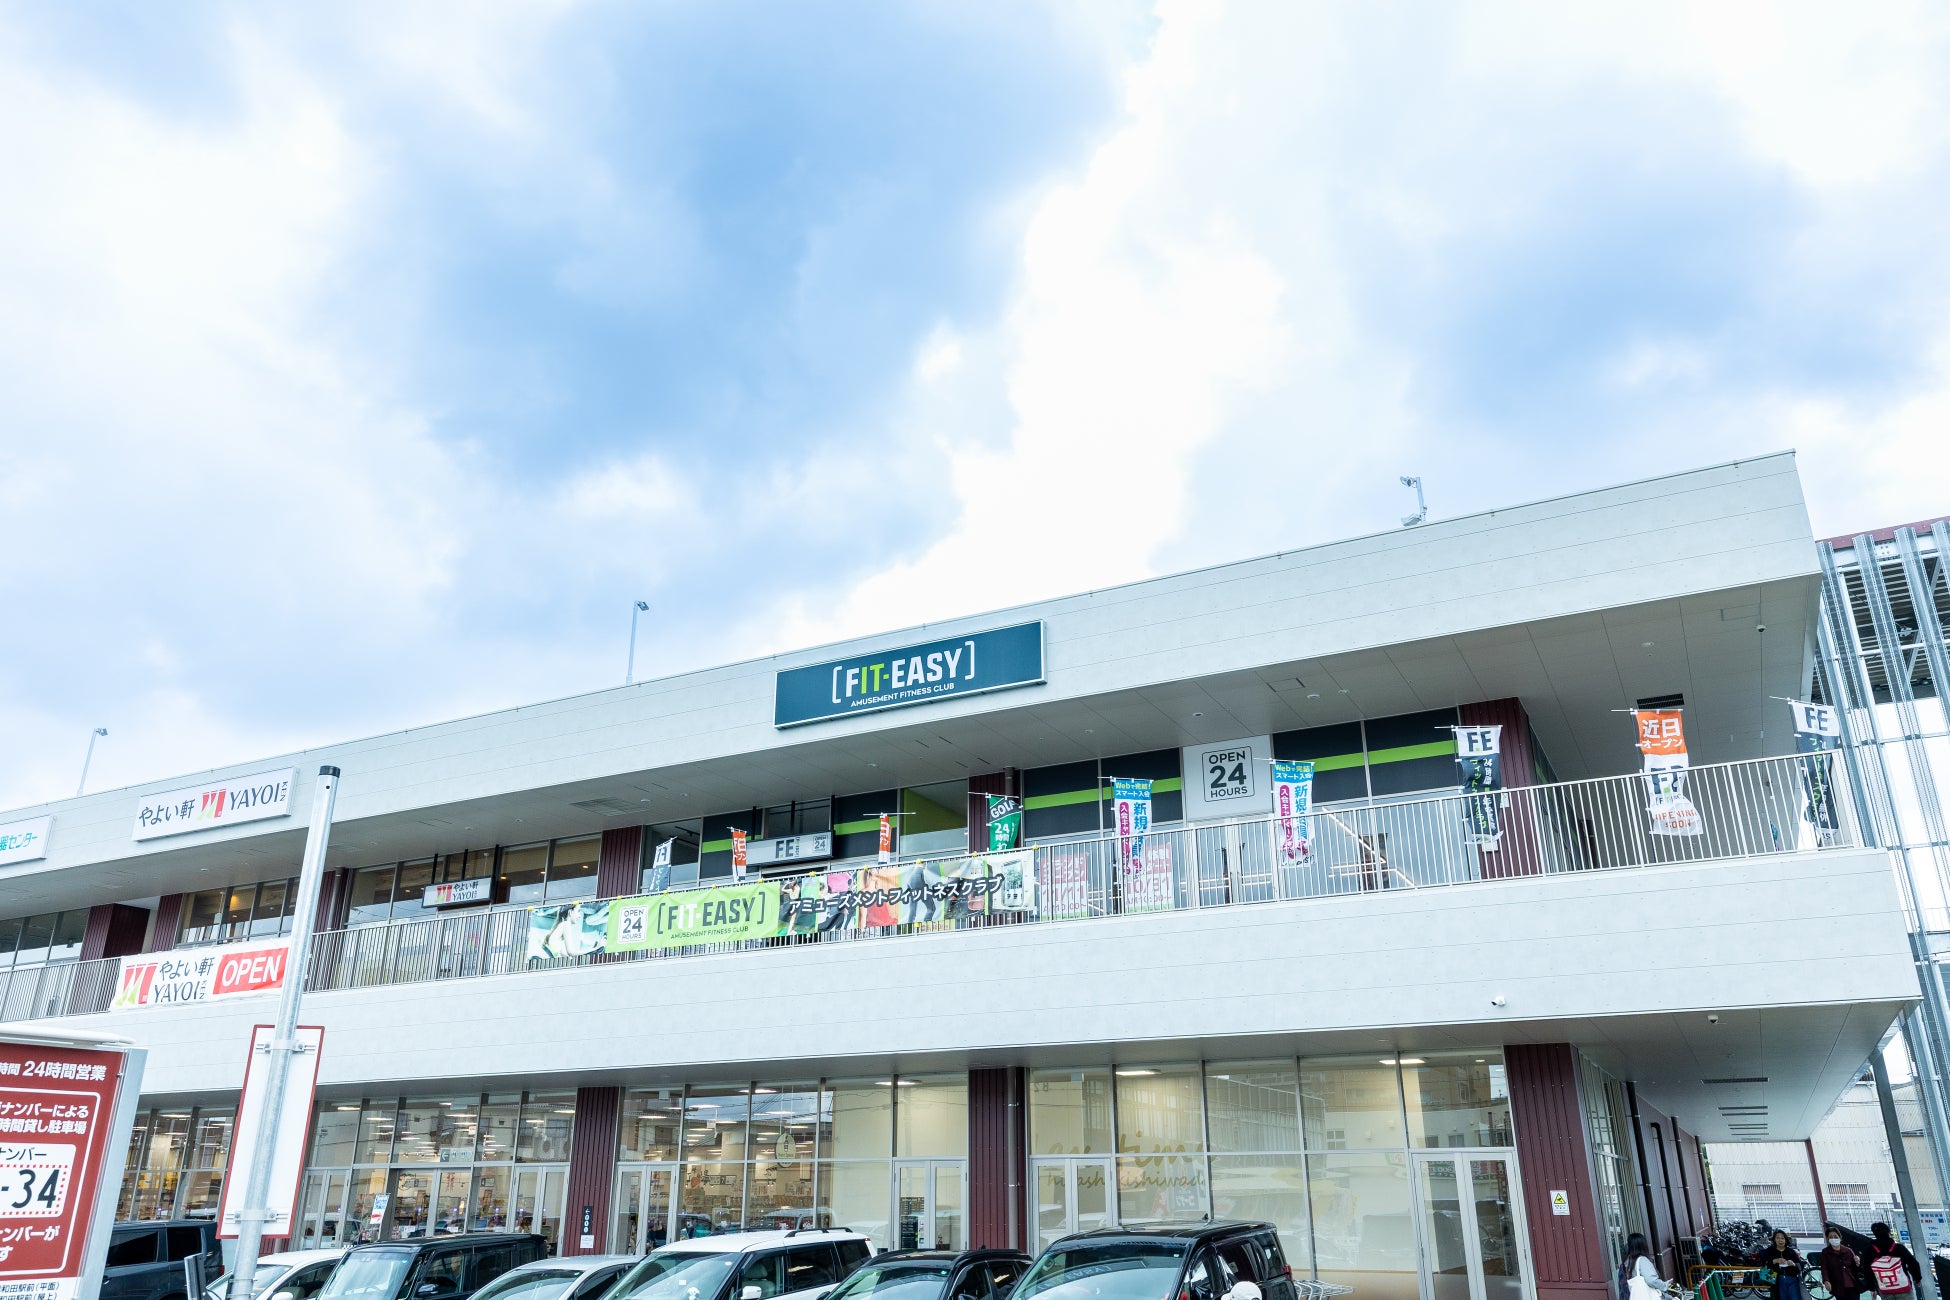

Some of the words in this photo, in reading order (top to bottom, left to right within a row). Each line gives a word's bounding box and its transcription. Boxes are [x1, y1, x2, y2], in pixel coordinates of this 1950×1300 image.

[850, 692, 898, 707] AMUSEMENT
[900, 687, 932, 699] FITNESS
[934, 683, 955, 693] CLUB
[1642, 718, 1681, 739] 近日
[1642, 738, 1683, 749] オープン
[1208, 751, 1246, 764] OPEN
[1210, 762, 1247, 788] 24
[229, 782, 281, 811] YAYOI
[1210, 786, 1248, 798] HOURS
[138, 798, 196, 828] やよい軒
[995, 822, 1010, 834] 24
[453, 890, 475, 902] YAYOI
[789, 876, 1004, 913] アミューズメントフィットネスクラブ
[624, 908, 644, 917] OPEN
[622, 917, 643, 934] 24
[670, 930, 707, 940] AMUSEMENT
[707, 928, 732, 936] FITNESS
[732, 925, 749, 933] CLUB
[621, 932, 642, 940] HOURS
[159, 956, 215, 982] やよい軒
[221, 954, 283, 987] OPEN
[153, 980, 201, 1004] YAYOI
[22, 1060, 107, 1081] 24時間営業
[0, 1101, 89, 1119] ナンバーによる
[0, 1225, 60, 1242] ンバーが
